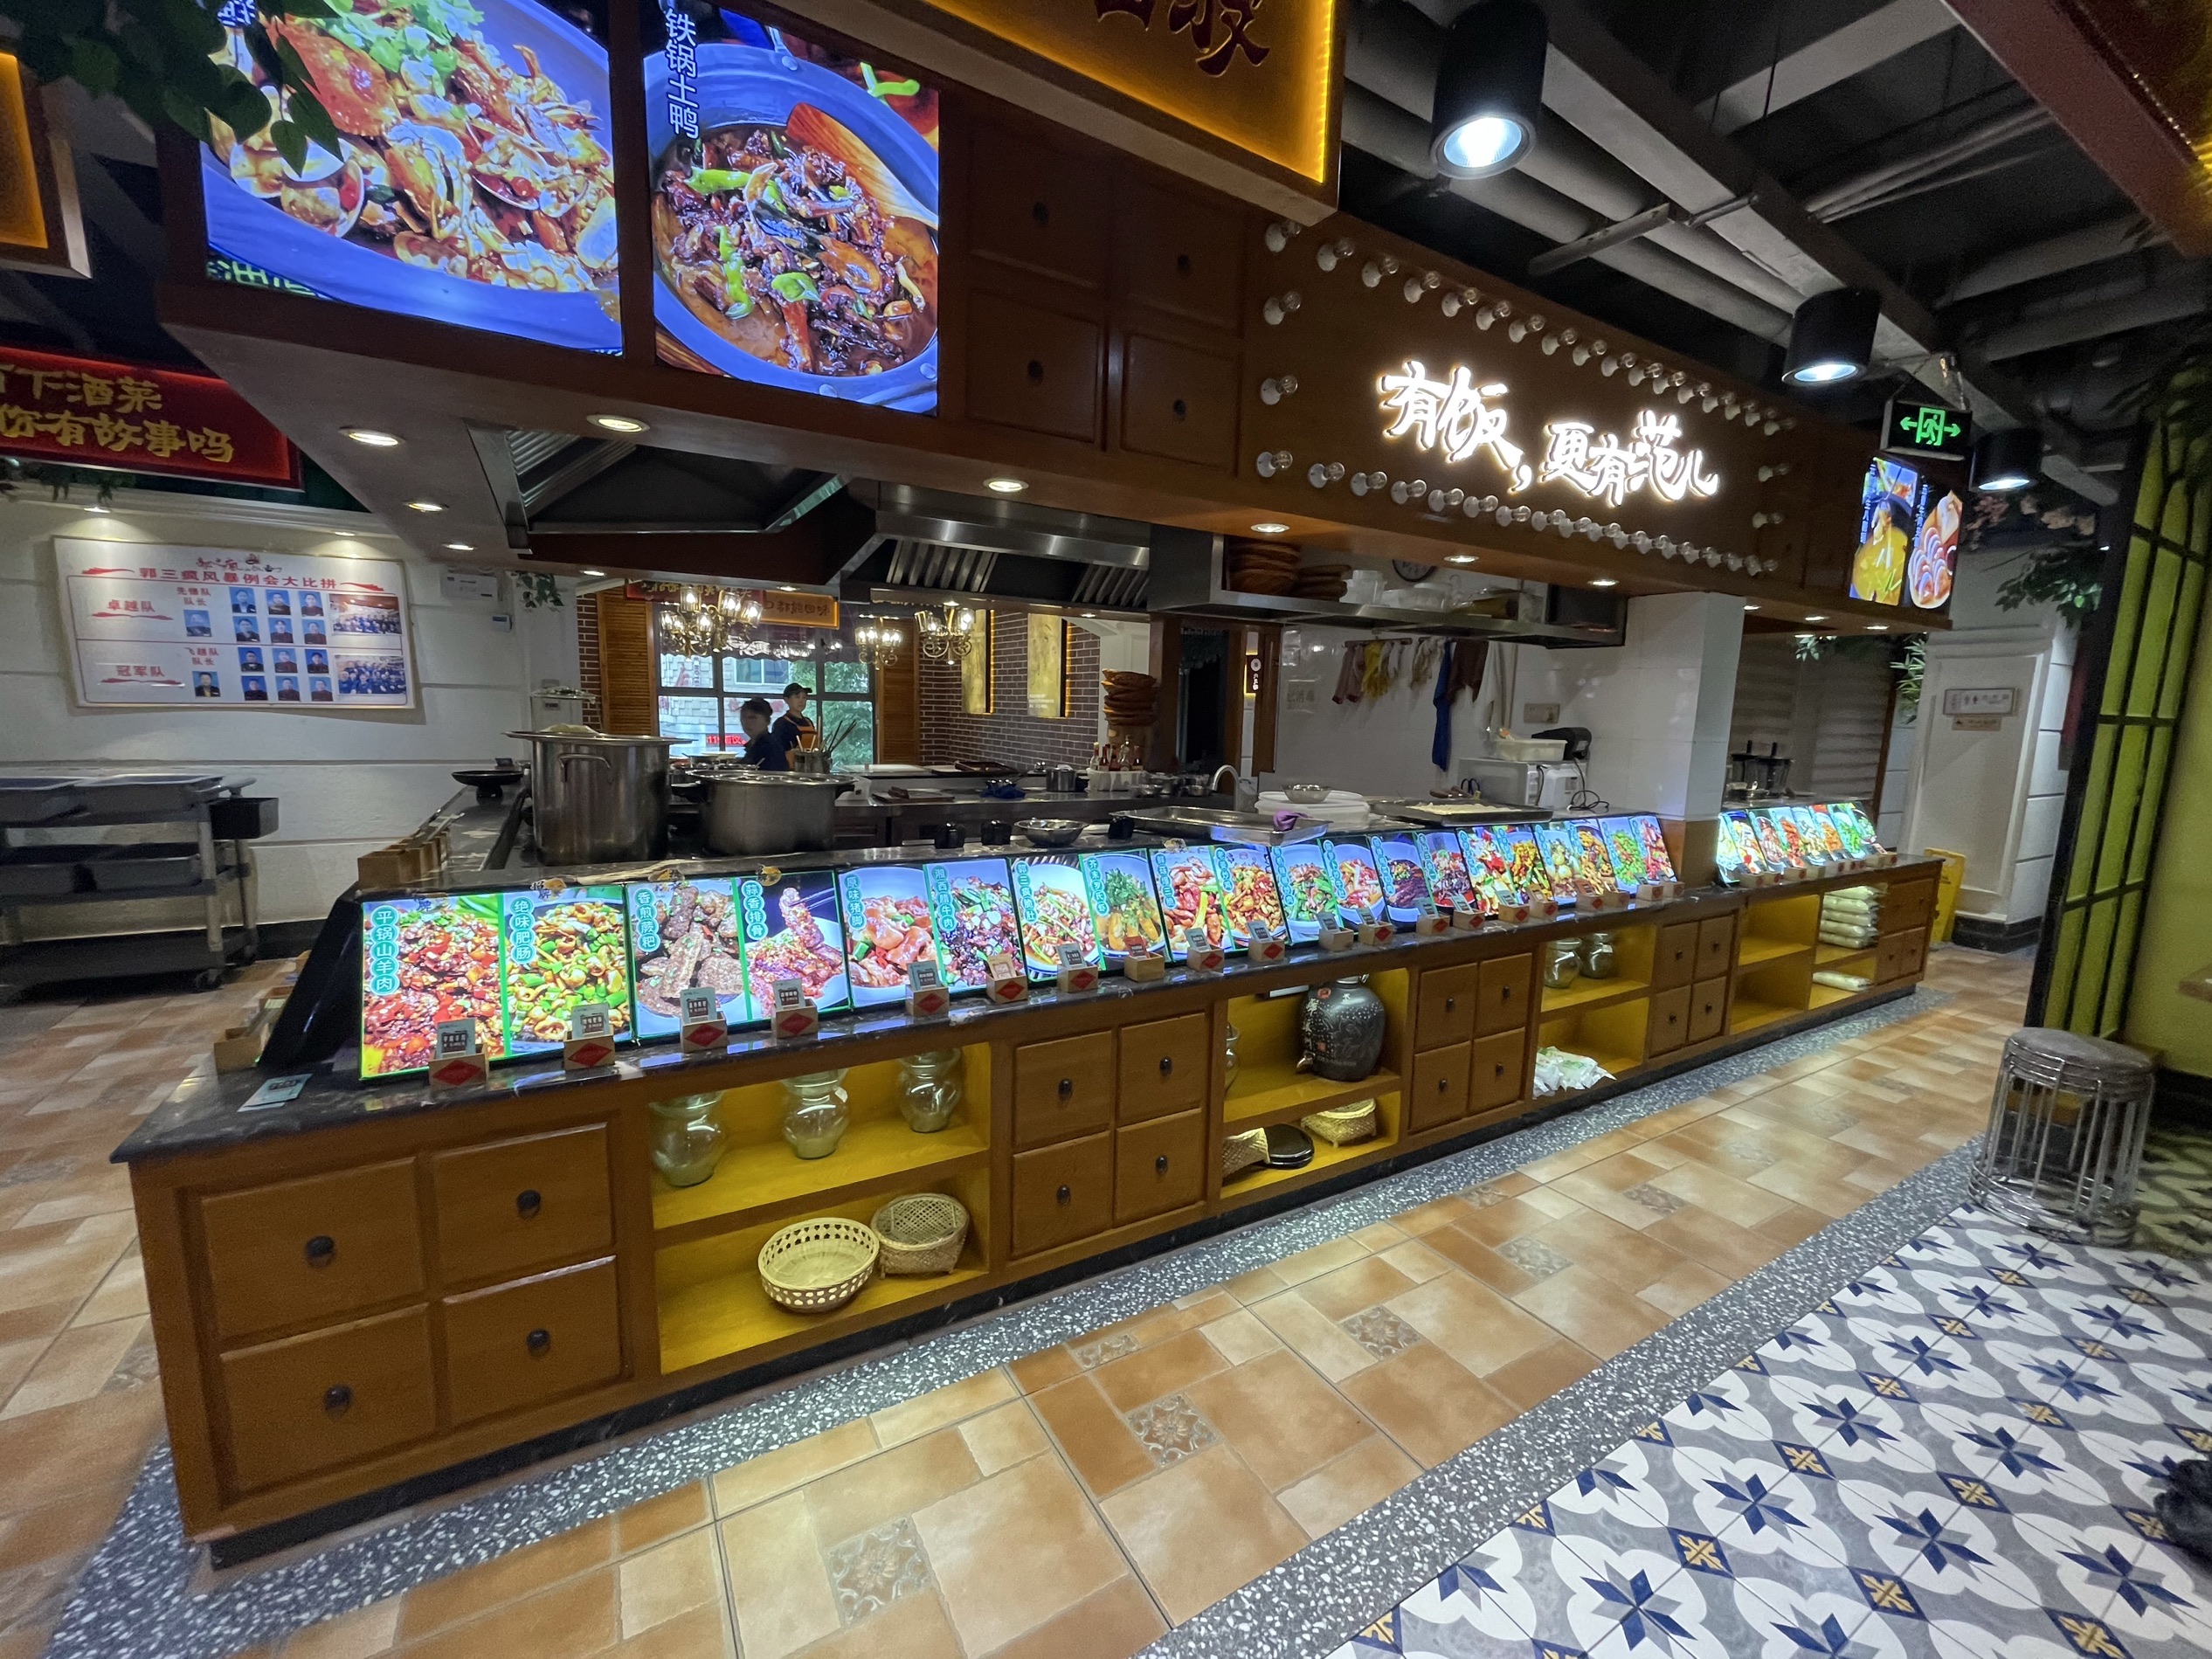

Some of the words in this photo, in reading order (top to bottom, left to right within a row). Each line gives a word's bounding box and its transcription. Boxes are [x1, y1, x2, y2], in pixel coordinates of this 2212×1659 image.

[665, 7, 700, 140] 铁锅土鸭
[107, 598, 156, 612] 卓越队
[116, 665, 165, 678] 冠军队
[743, 883, 764, 937] 蒜香排骨
[846, 876, 864, 926] 原味猪脚
[933, 868, 955, 929] 湘西腊牛肉
[375, 909, 395, 992] 平锅山羊肉
[514, 900, 532, 960] 绝味肥肠
